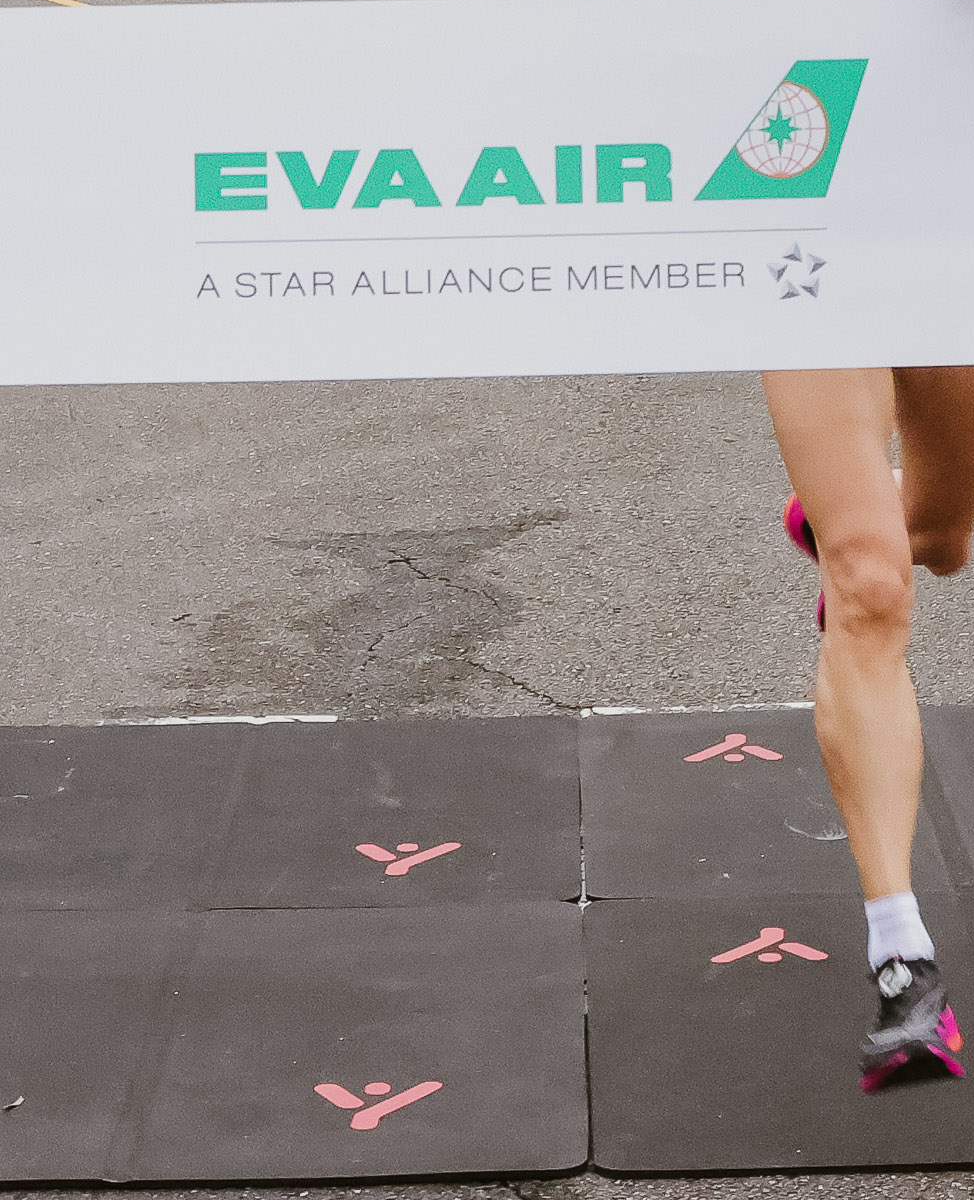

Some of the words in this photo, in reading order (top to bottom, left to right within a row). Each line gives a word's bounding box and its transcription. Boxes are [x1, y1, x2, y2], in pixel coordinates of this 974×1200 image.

[196, 273, 221, 299] A
[234, 270, 336, 298] STAR
[351, 266, 552, 296] ALLIANCE
[567, 262, 746, 291] MEMBER
